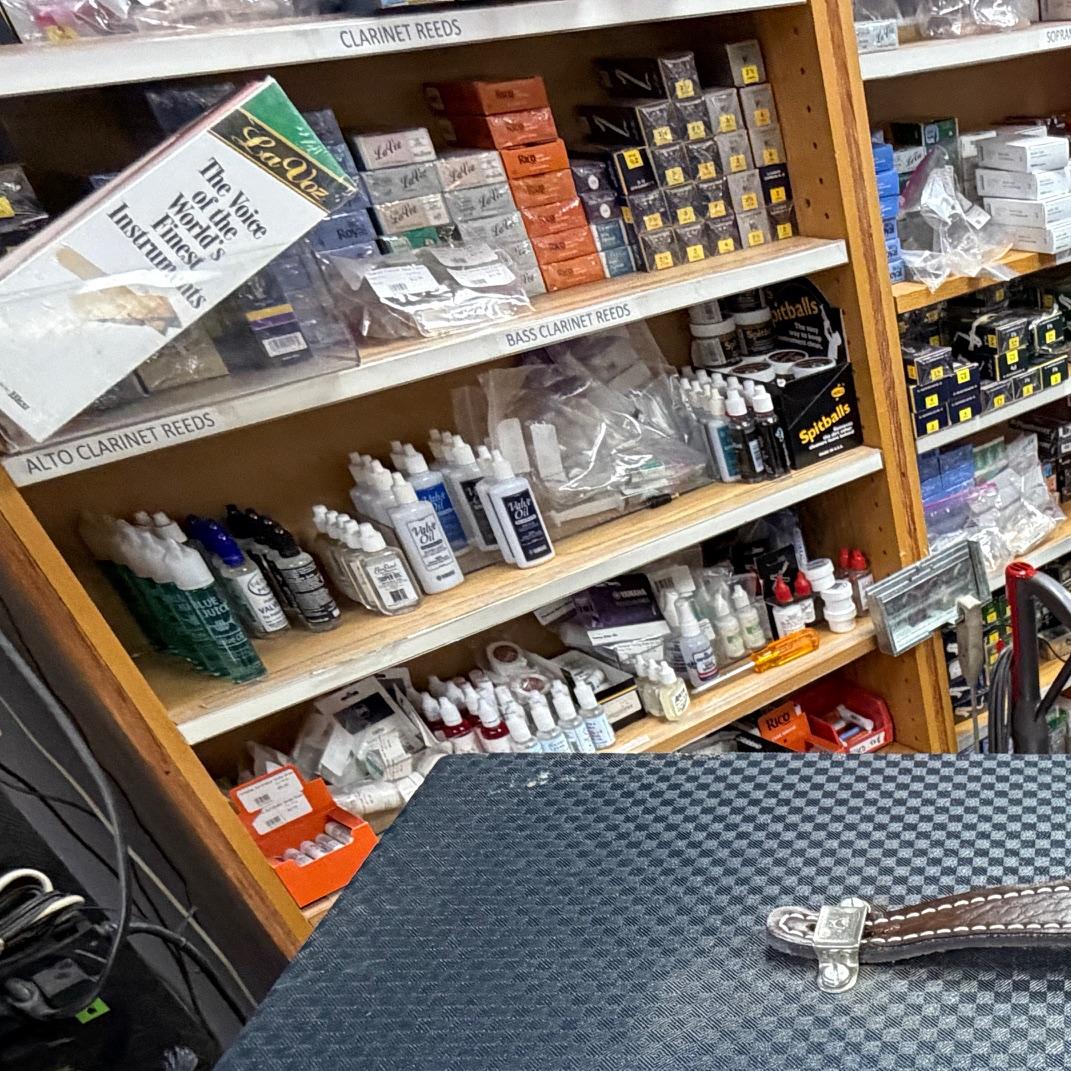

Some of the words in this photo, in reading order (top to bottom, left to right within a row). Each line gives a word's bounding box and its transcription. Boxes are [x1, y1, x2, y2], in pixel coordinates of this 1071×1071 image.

[340, 23, 412, 48] CLARINET
[414, 18, 462, 40] REEDS
[192, 190, 220, 210] of
[209, 208, 239, 242] the
[199, 157, 231, 198] The
[228, 190, 268, 240] Voice
[150, 211, 205, 272] Finest
[167, 192, 226, 262] World's
[107, 201, 207, 310] Instrumnts
[505, 327, 538, 347] BASS
[539, 312, 594, 339] CLARINET
[595, 303, 631, 324] REEDS
[771, 296, 819, 328] pitballs
[26, 448, 74, 475] ALTO
[76, 426, 159, 461] CLARINET
[160, 412, 215, 439] REEDS
[799, 402, 851, 445] Spitballs
[411, 520, 437, 537] Valve
[513, 508, 529, 520] Oil
[418, 532, 435, 544] Oil
[258, 600, 280, 614] VALV
[765, 712, 791, 731] RICO
